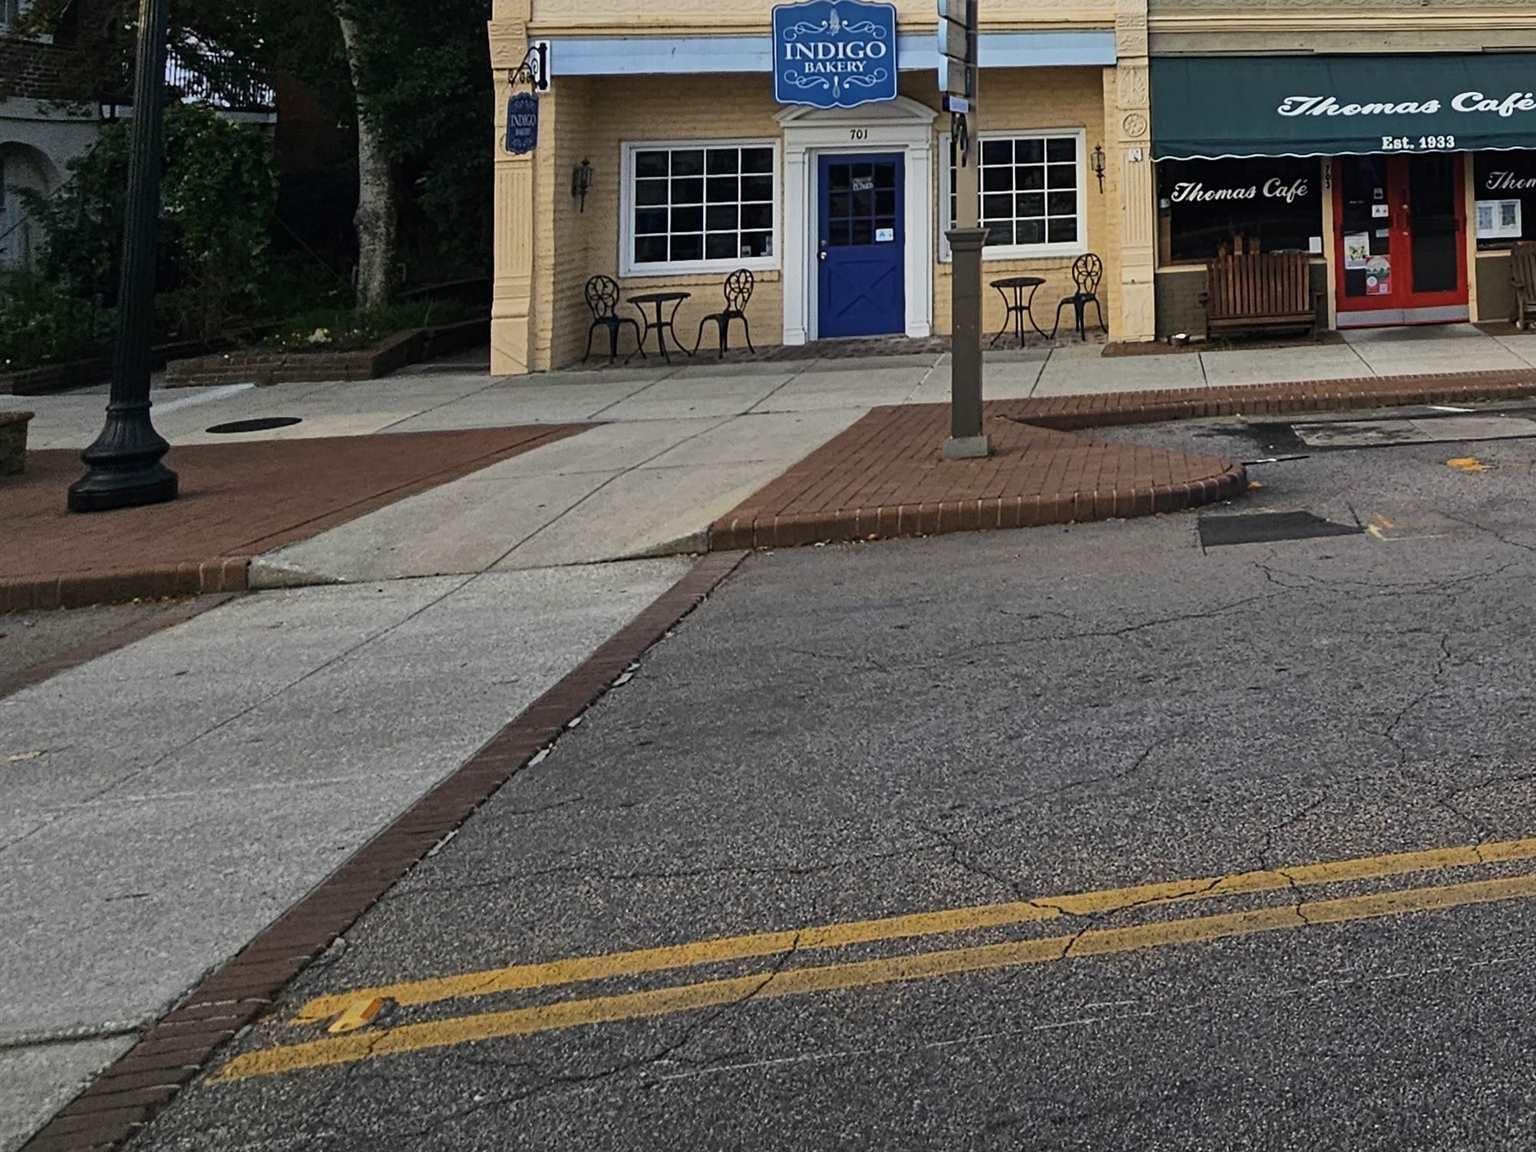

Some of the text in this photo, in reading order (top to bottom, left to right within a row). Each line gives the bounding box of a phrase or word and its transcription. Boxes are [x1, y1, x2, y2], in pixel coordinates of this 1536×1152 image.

[785, 41, 887, 60] INDIGO
[804, 61, 867, 73] BAKERY
[1277, 96, 1442, 116] Thomas
[511, 113, 537, 128] INDIGO
[850, 129, 868, 140] 701
[1381, 135, 1456, 150] Est. 1933
[1171, 177, 1309, 204] Thomas Café
